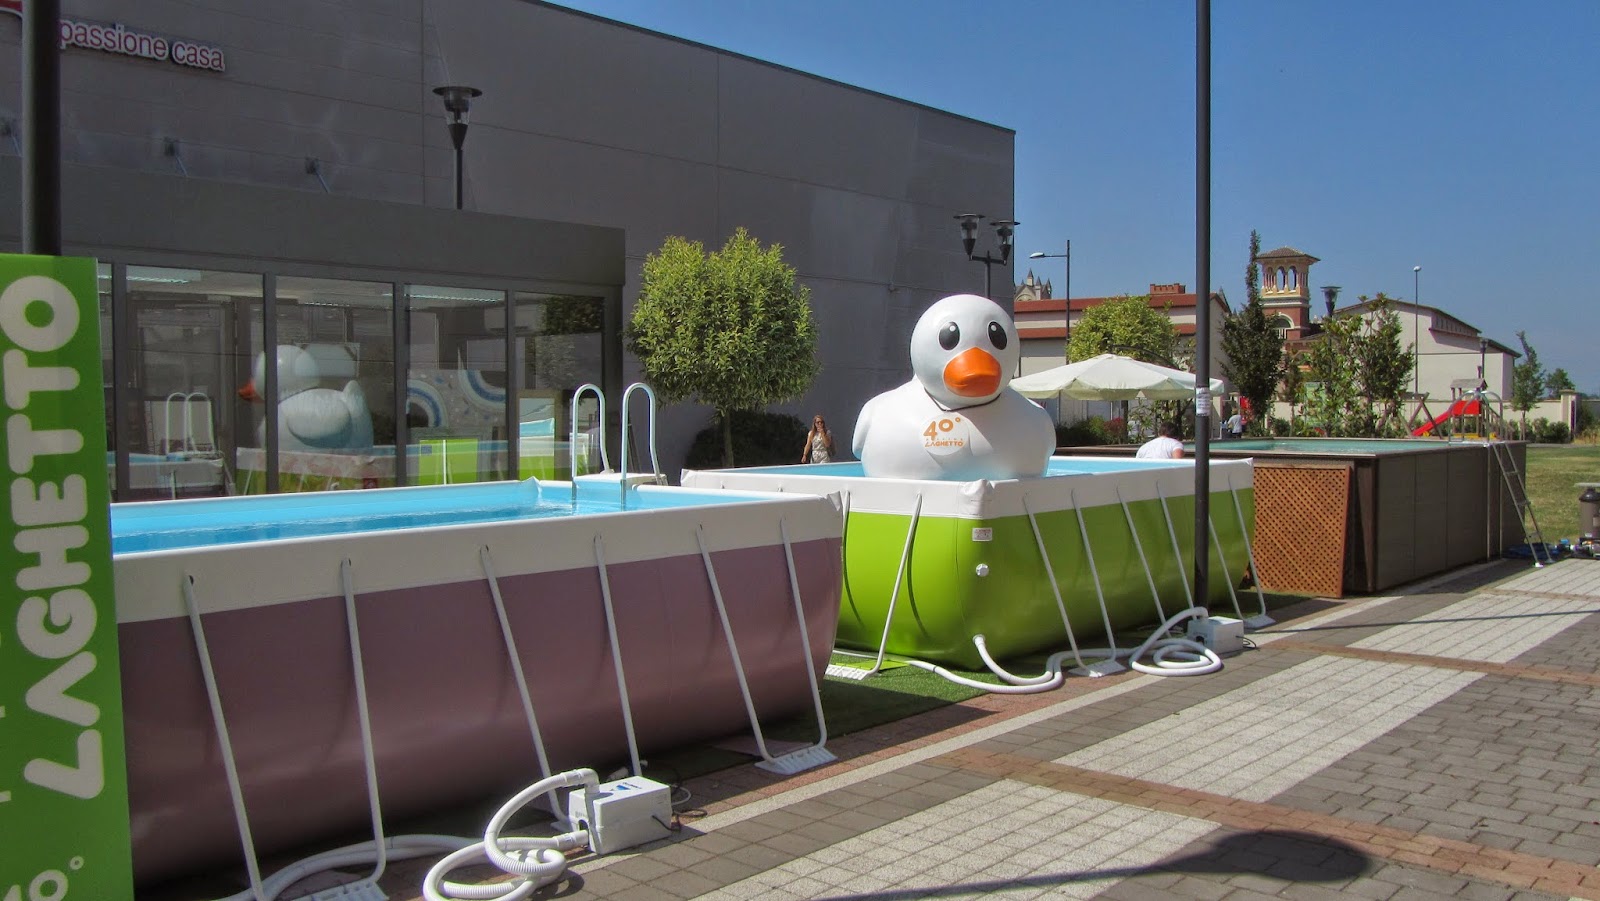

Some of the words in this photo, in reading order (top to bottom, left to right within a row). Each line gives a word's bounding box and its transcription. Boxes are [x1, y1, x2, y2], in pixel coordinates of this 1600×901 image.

[60, 20, 168, 60] passione
[172, 41, 225, 71] casa
[0, 275, 104, 799] LAGHETTO
